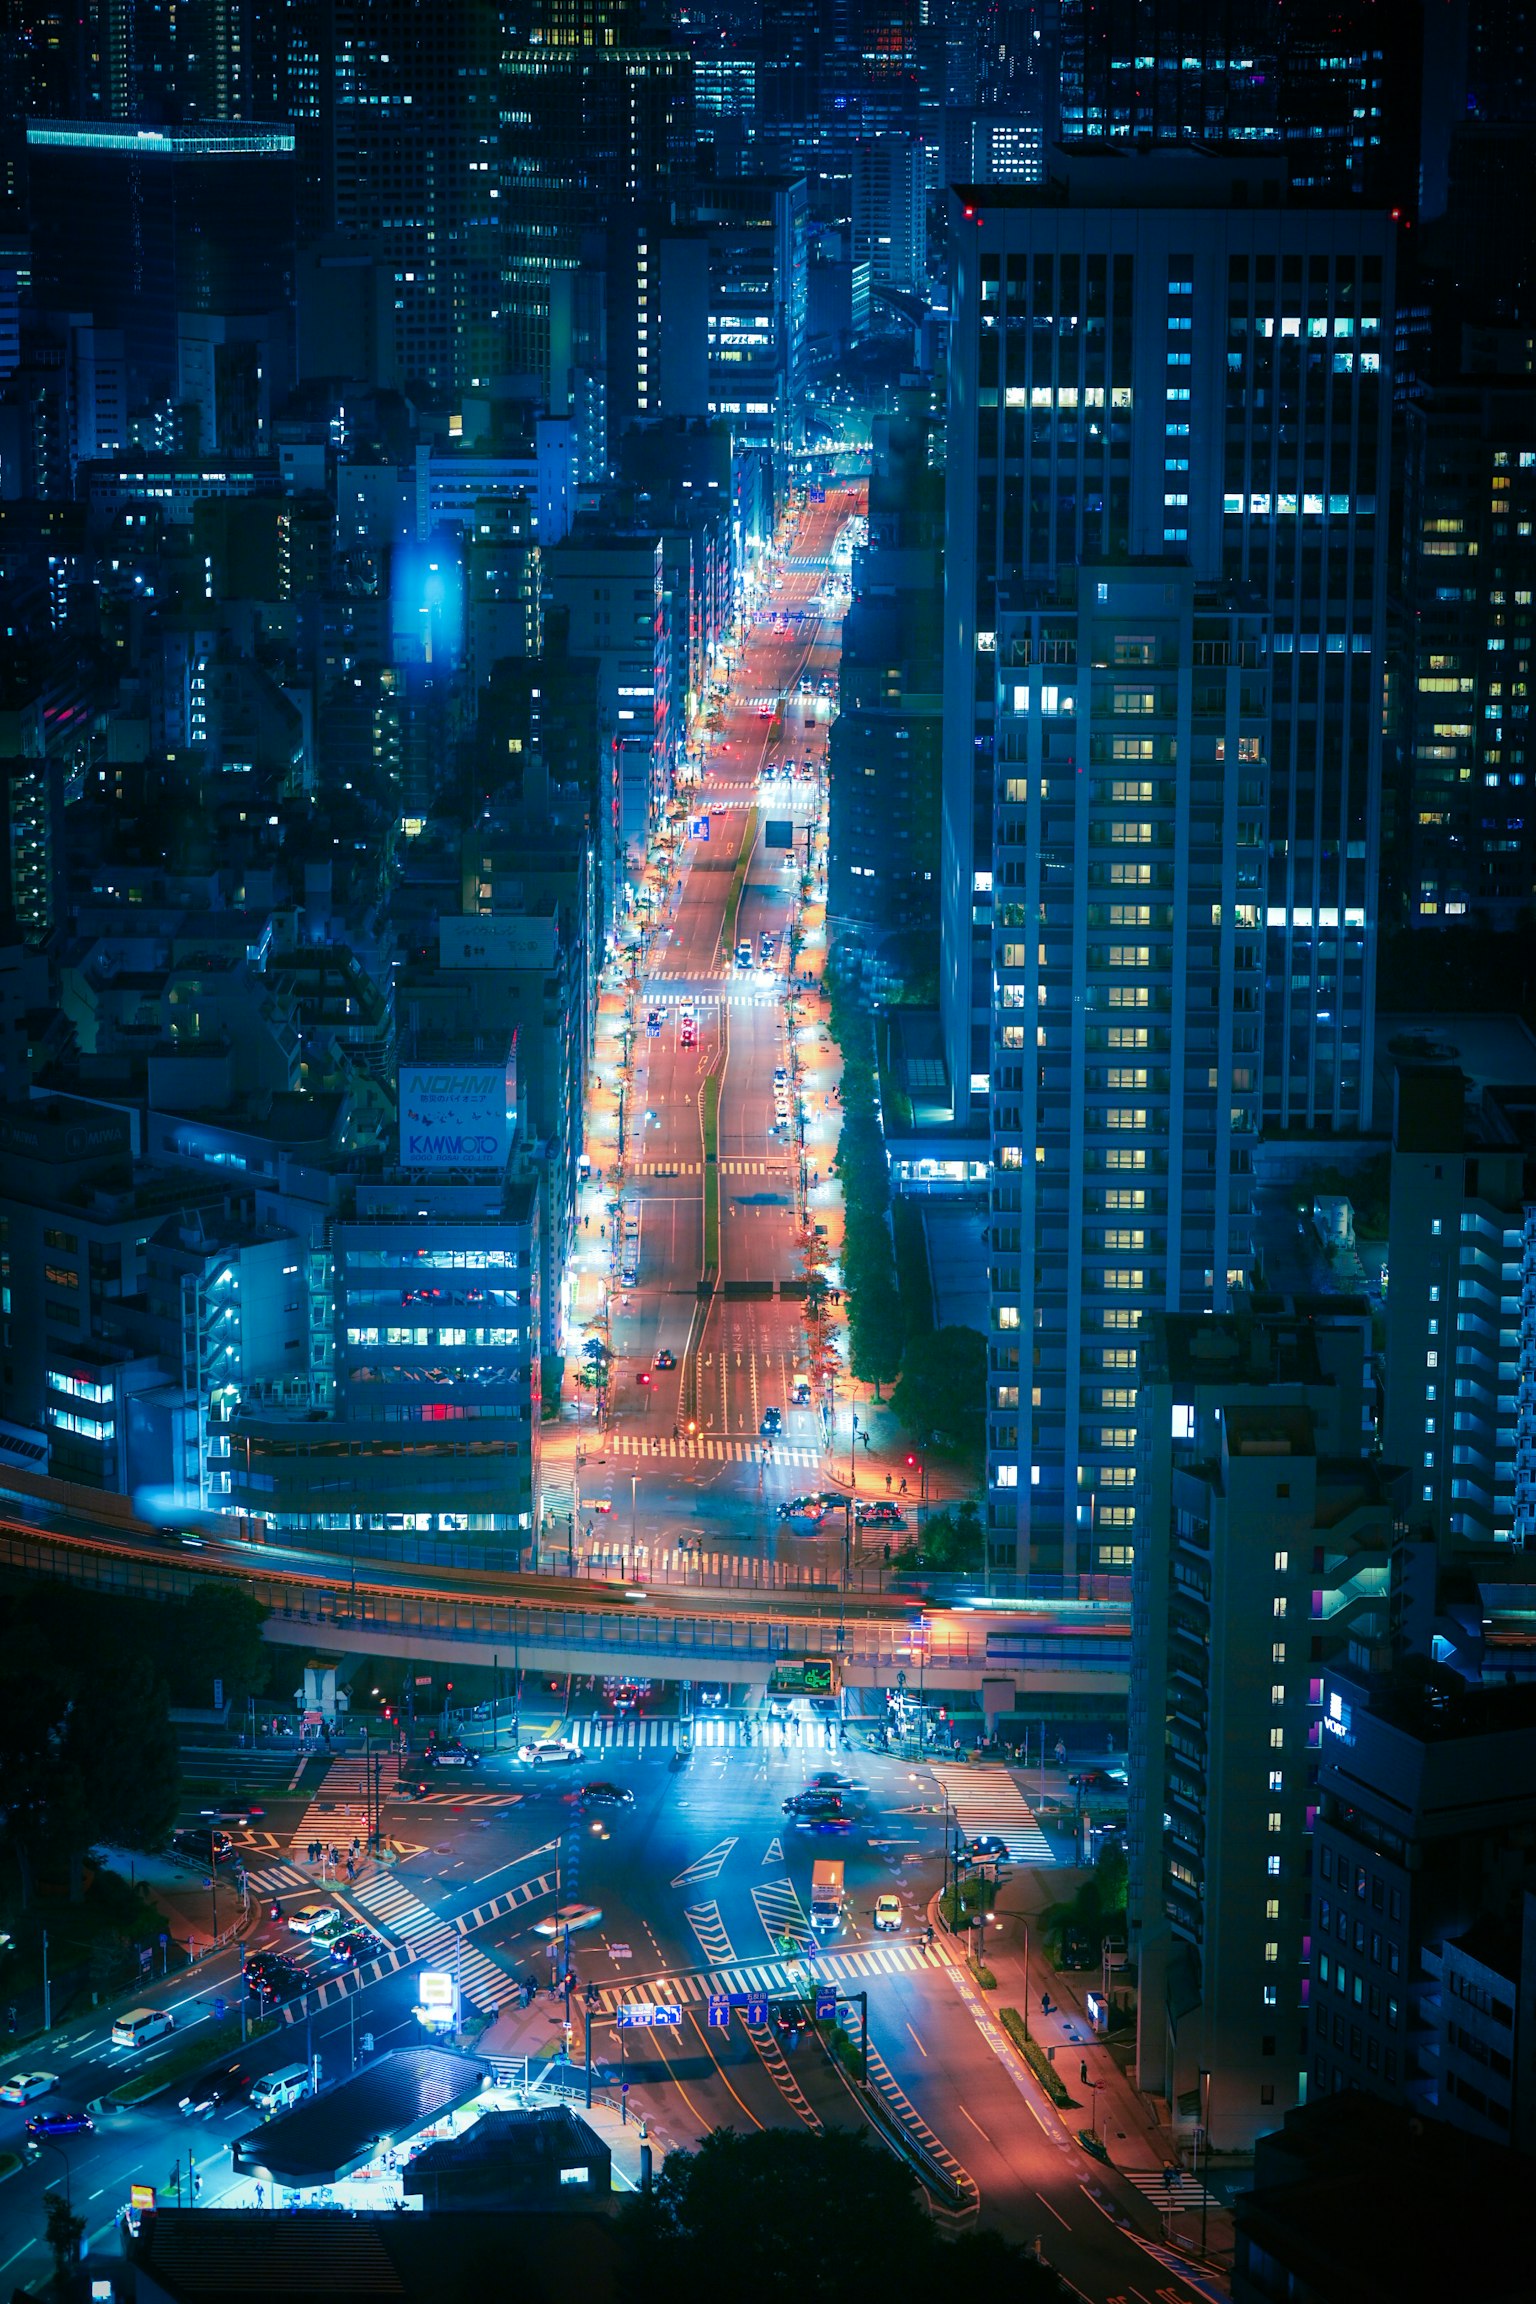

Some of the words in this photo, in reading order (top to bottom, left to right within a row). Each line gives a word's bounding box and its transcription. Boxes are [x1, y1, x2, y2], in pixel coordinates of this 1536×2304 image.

[409, 1075, 498, 1093] NOHMI
[88, 1127, 122, 1145] MIWA
[409, 1135, 498, 1154] KAWAMOTO
[1324, 1716, 1348, 1736] VORT
